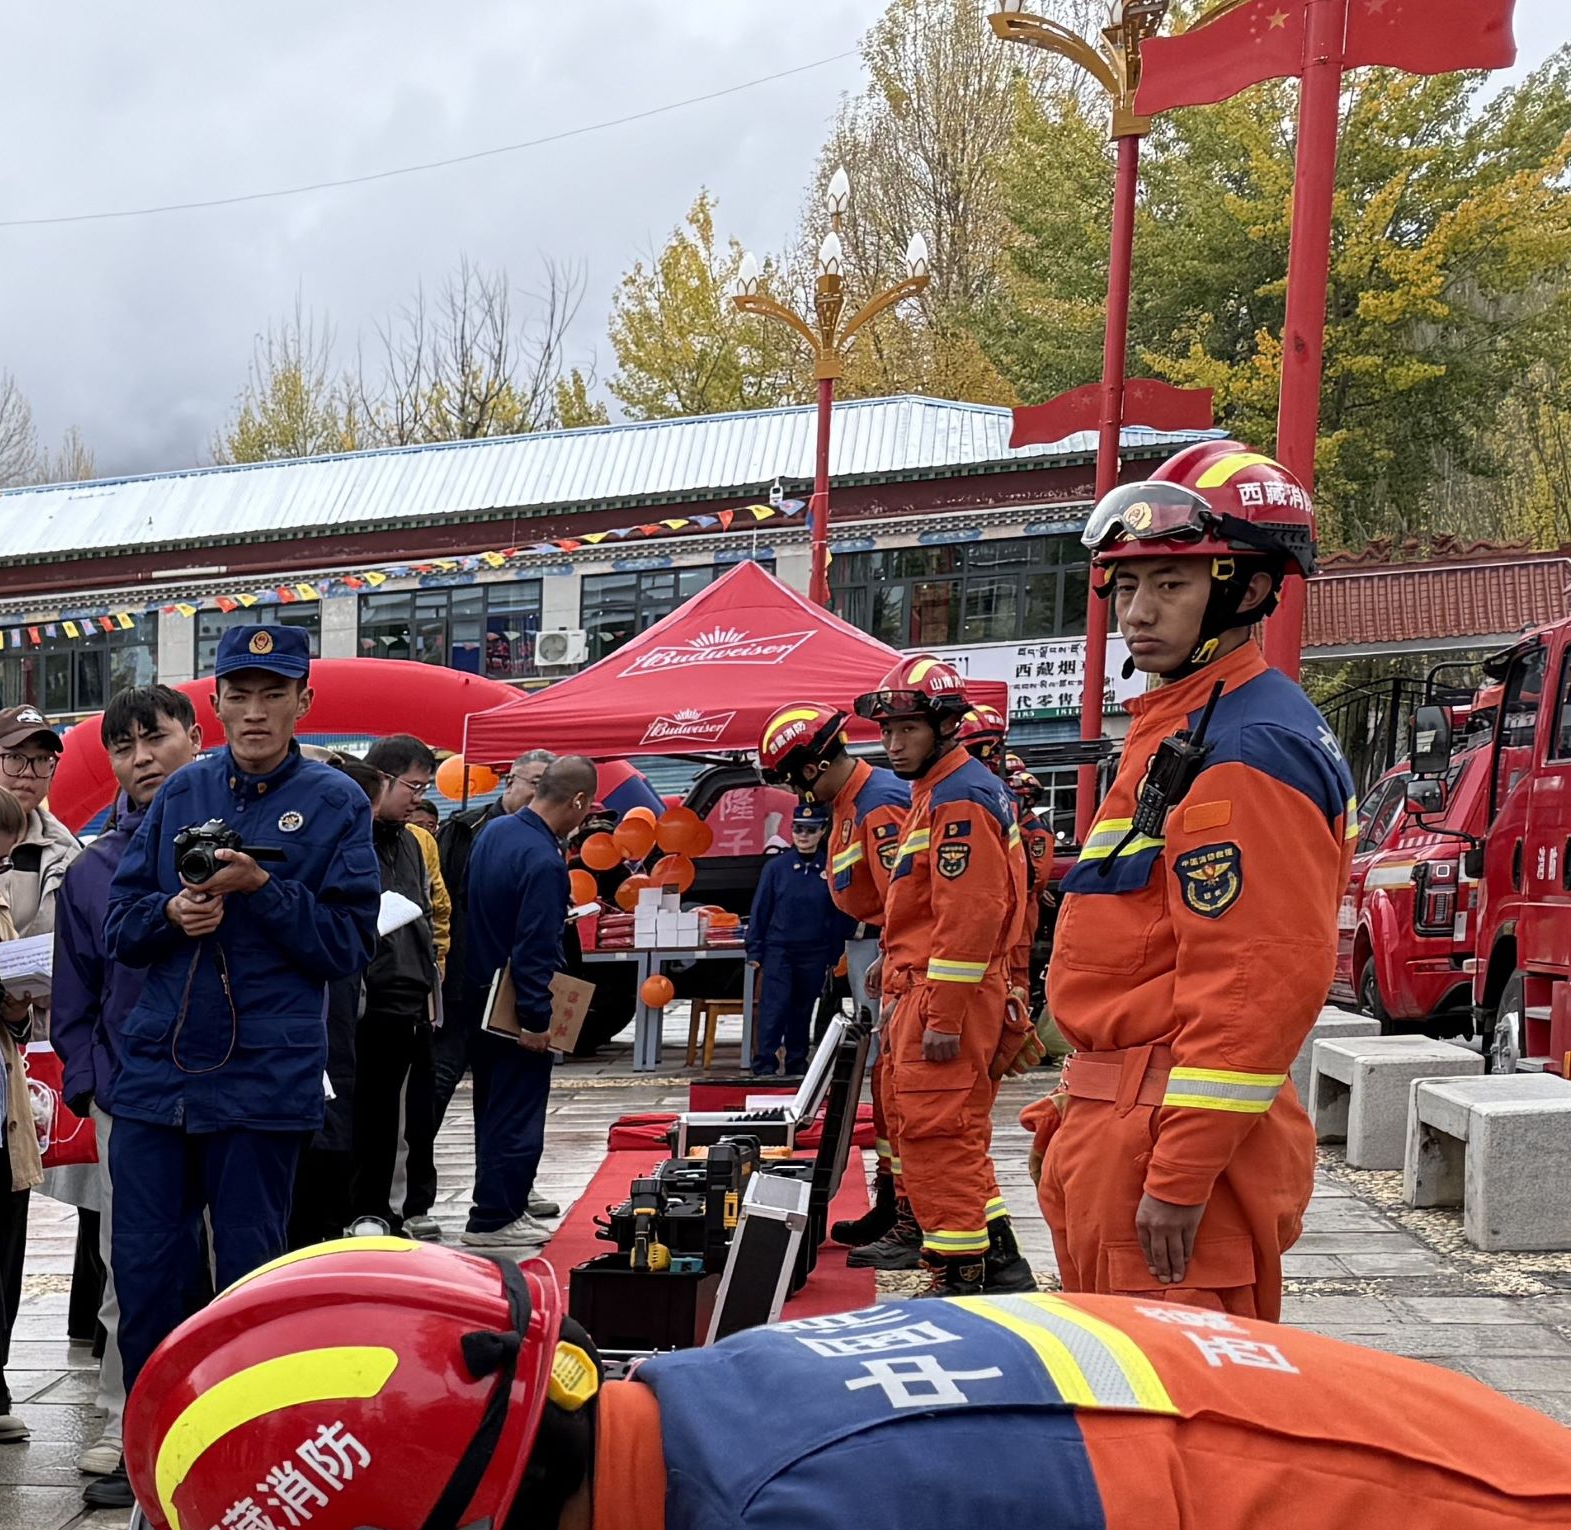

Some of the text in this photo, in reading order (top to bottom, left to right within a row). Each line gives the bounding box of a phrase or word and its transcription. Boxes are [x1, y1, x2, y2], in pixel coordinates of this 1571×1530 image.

[636, 642, 793, 668] Budweiser
[1015, 659, 1087, 679] 西藏烟
[1016, 689, 1116, 710] 代零售
[647, 721, 726, 737] Budweiser
[752, 1304, 1003, 1409] 中国消
